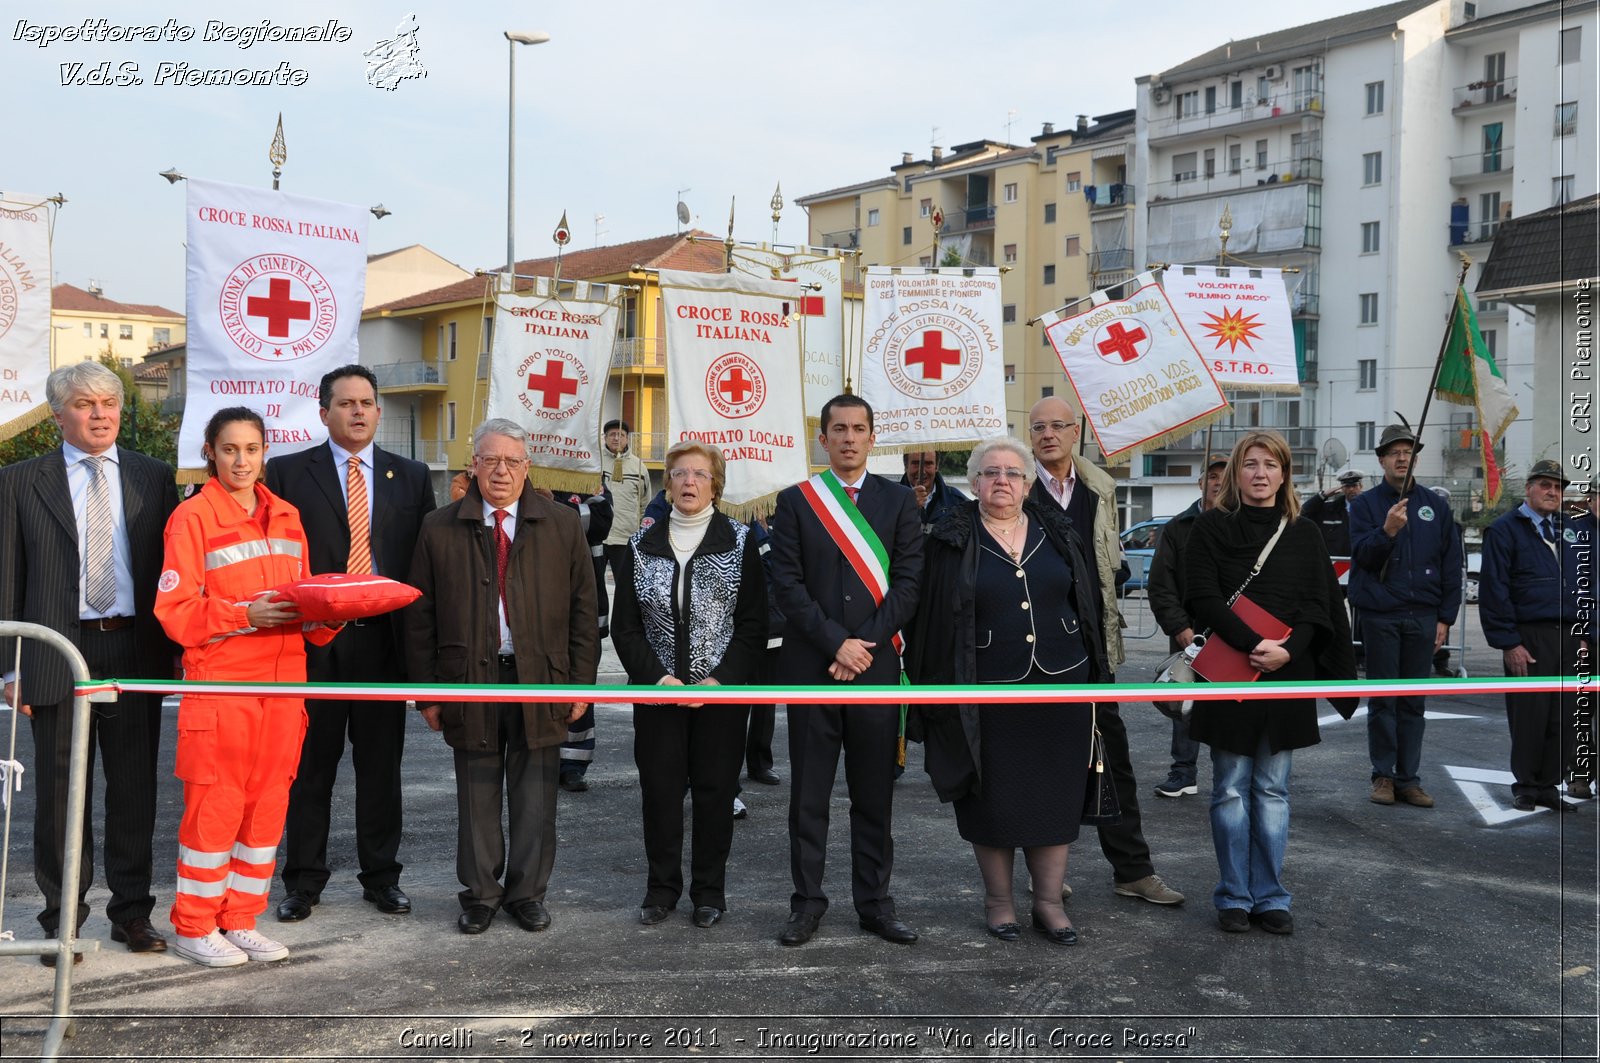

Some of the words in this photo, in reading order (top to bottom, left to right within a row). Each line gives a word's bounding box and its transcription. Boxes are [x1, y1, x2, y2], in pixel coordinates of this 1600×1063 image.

[199, 206, 247, 227] CROCE
[252, 214, 293, 234] ROSSA
[298, 222, 360, 244] ITALIANA
[241, 263, 257, 279] DI
[259, 256, 313, 282] GINEVRA
[311, 280, 327, 294] 22
[897, 279, 938, 287] VOLONTARI
[941, 280, 956, 288] DEL
[959, 280, 996, 290] SOCCORSO
[898, 288, 940, 297] FEMMINILE
[942, 289, 947, 297] E
[949, 290, 982, 298] PIONIERI
[1197, 282, 1255, 290] VOLONTARI
[1185, 292, 1231, 300] "PULMINO
[1235, 294, 1271, 302] AMICO"
[223, 275, 263, 354] CONVENZIONE
[312, 297, 334, 341] AGOSTO
[511, 306, 558, 321] CROCE
[677, 304, 732, 321] CROCE
[740, 309, 789, 328] ROSSA
[525, 322, 589, 340] ITALIANA
[866, 311, 900, 355] CROCE
[899, 298, 949, 316] ROSSA
[952, 303, 999, 353] ITALIANA
[900, 325, 912, 335] DI
[916, 316, 962, 333] GINEVRA
[696, 324, 772, 344] ITALIANA
[962, 331, 975, 344] 22
[292, 338, 316, 356] 1864
[516, 351, 542, 378] CORPO
[545, 348, 589, 386] VOLONTARI
[715, 363, 723, 372] DI
[887, 335, 922, 397] CONVENZIONE
[965, 344, 980, 379] AGOSTO
[3, 369, 17, 381] DI
[1099, 373, 1158, 408] GRUPPO
[1161, 359, 1195, 380] V.D.S.
[210, 379, 285, 395] COMITATO
[944, 378, 968, 395] 1864
[1155, 384, 1175, 402] DON
[266, 404, 282, 417] DI
[518, 392, 533, 412] DEL
[535, 399, 585, 421] SOCCORSO
[873, 406, 929, 421] COMITATO
[933, 404, 980, 416] LOCALE
[983, 405, 994, 415] DI
[914, 420, 926, 430] S.
[930, 417, 1002, 430] DALMAZZO
[565, 437, 577, 446] DI
[680, 429, 743, 445] COMITATO
[749, 429, 794, 448] LOCALE
[723, 447, 773, 462] CANELLI
